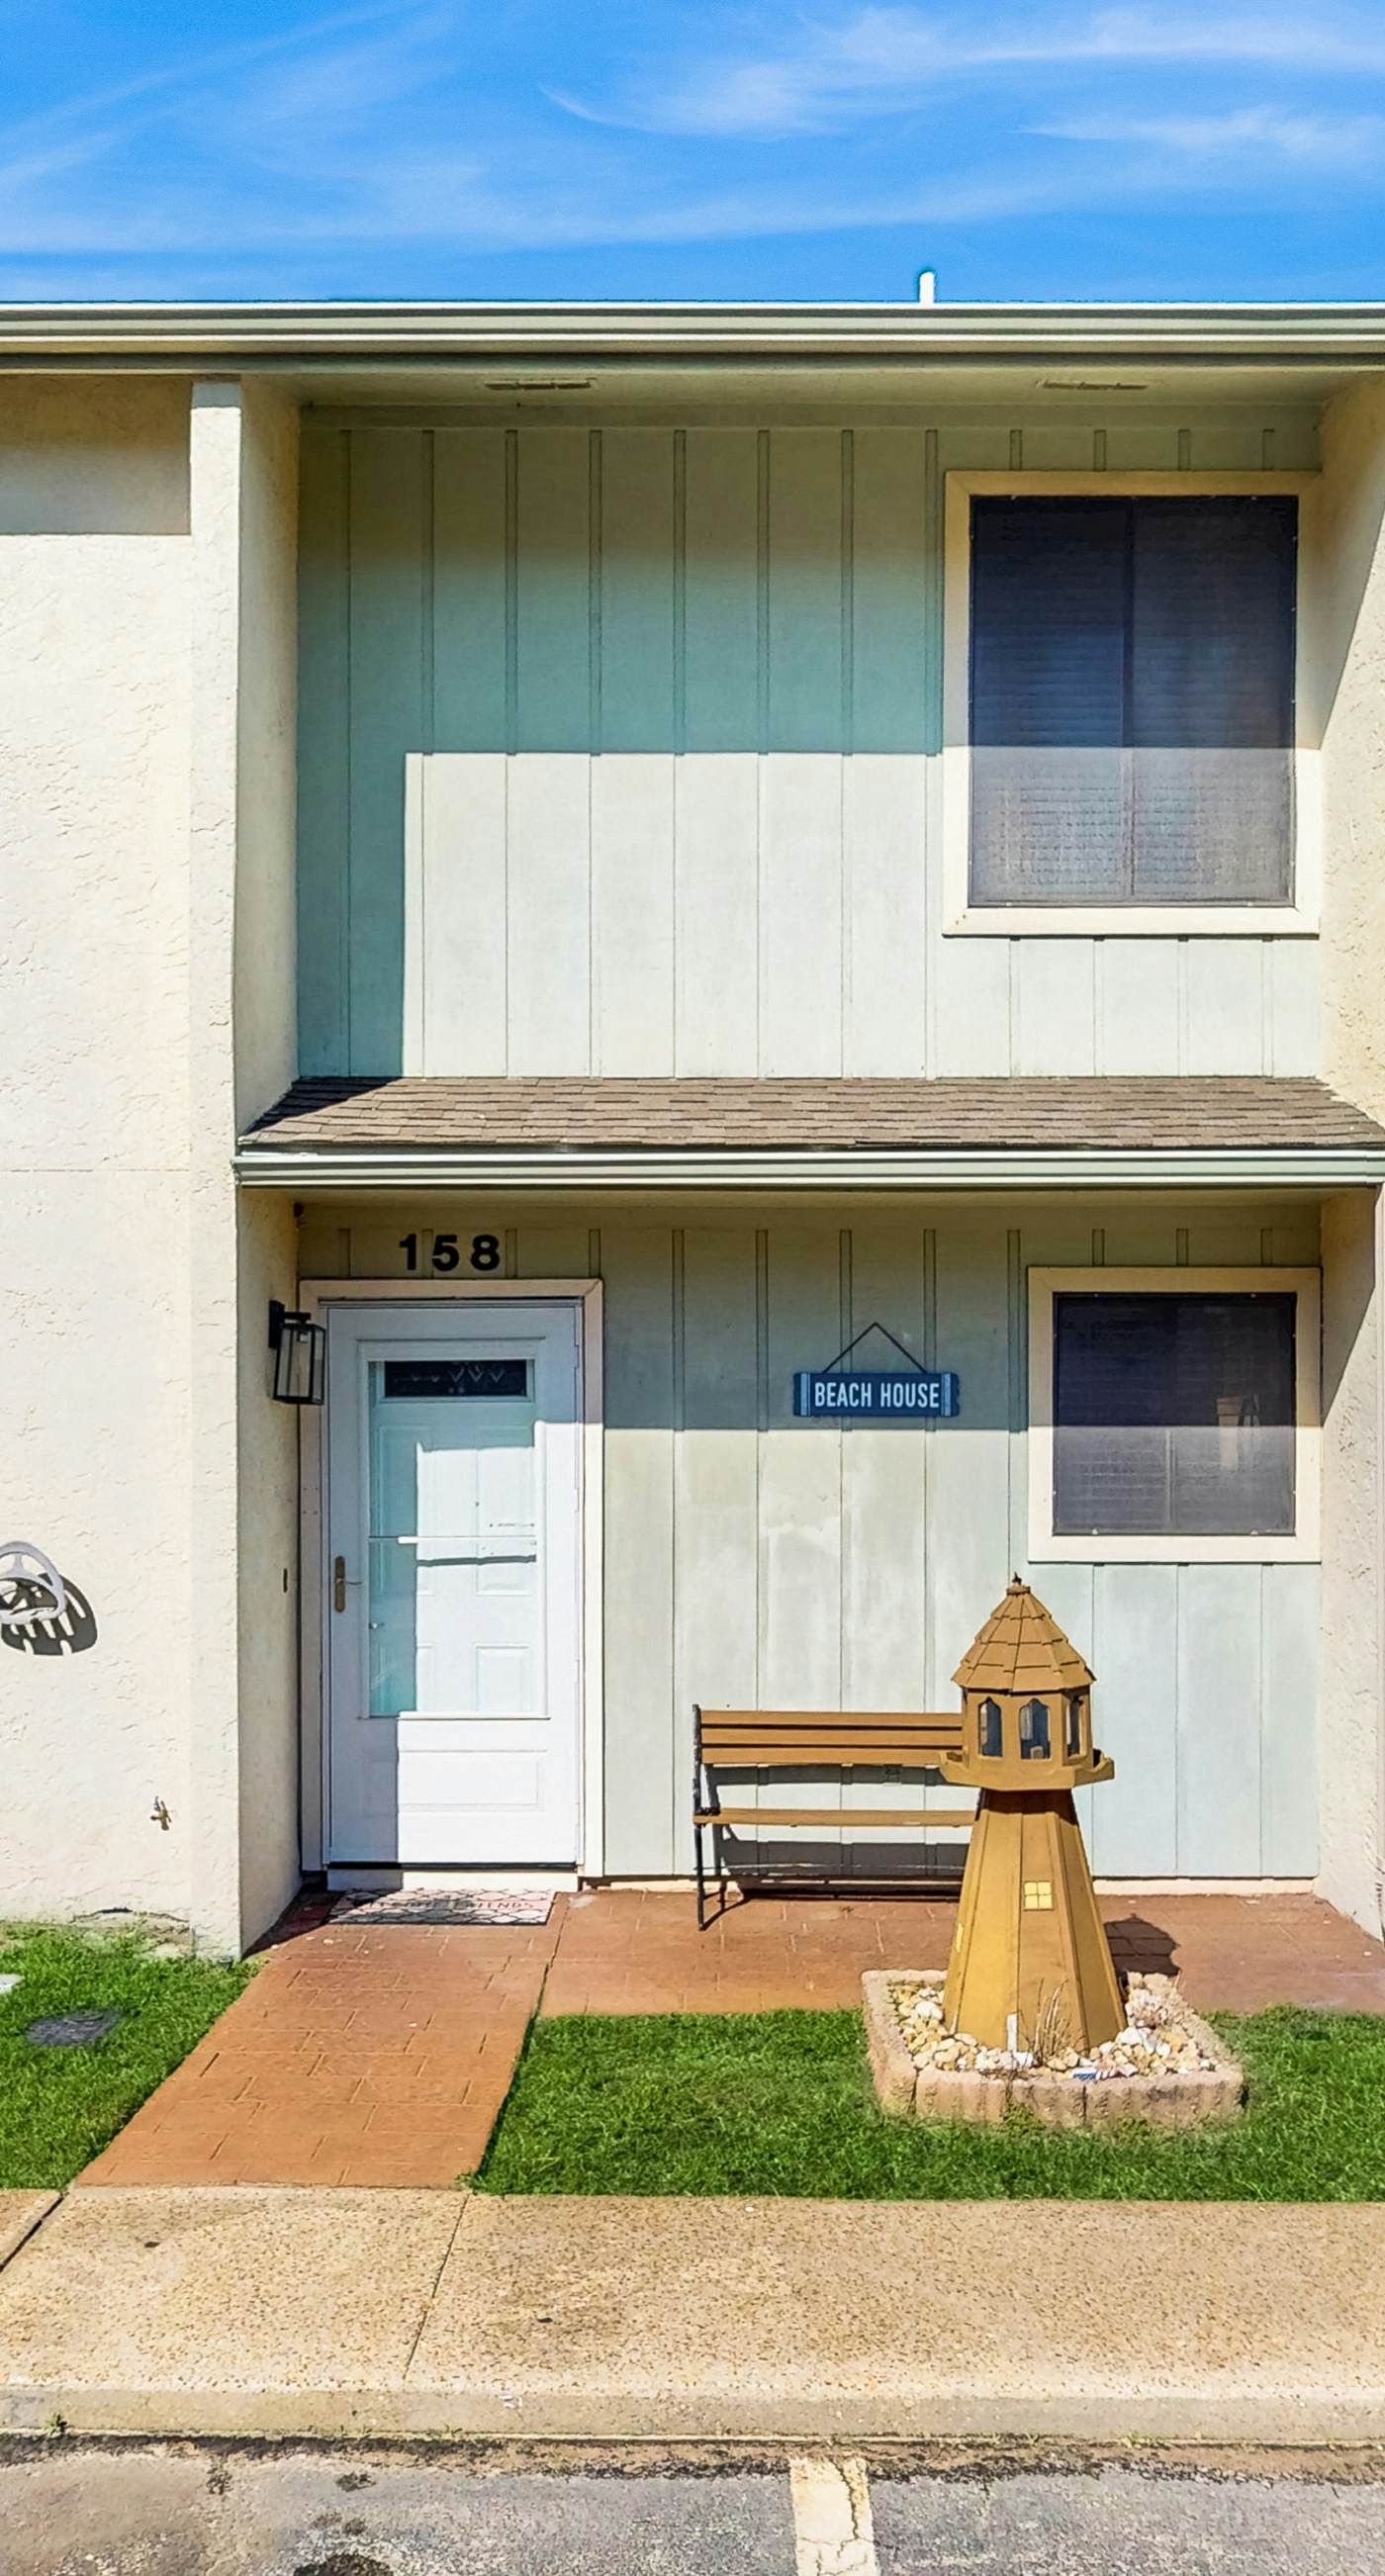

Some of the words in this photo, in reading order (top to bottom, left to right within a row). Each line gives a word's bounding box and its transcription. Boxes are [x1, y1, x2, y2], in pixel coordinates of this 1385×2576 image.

[399, 1234, 501, 1271] 158
[814, 1382, 873, 1408] BEACH
[879, 1382, 940, 1408] HOUSE
